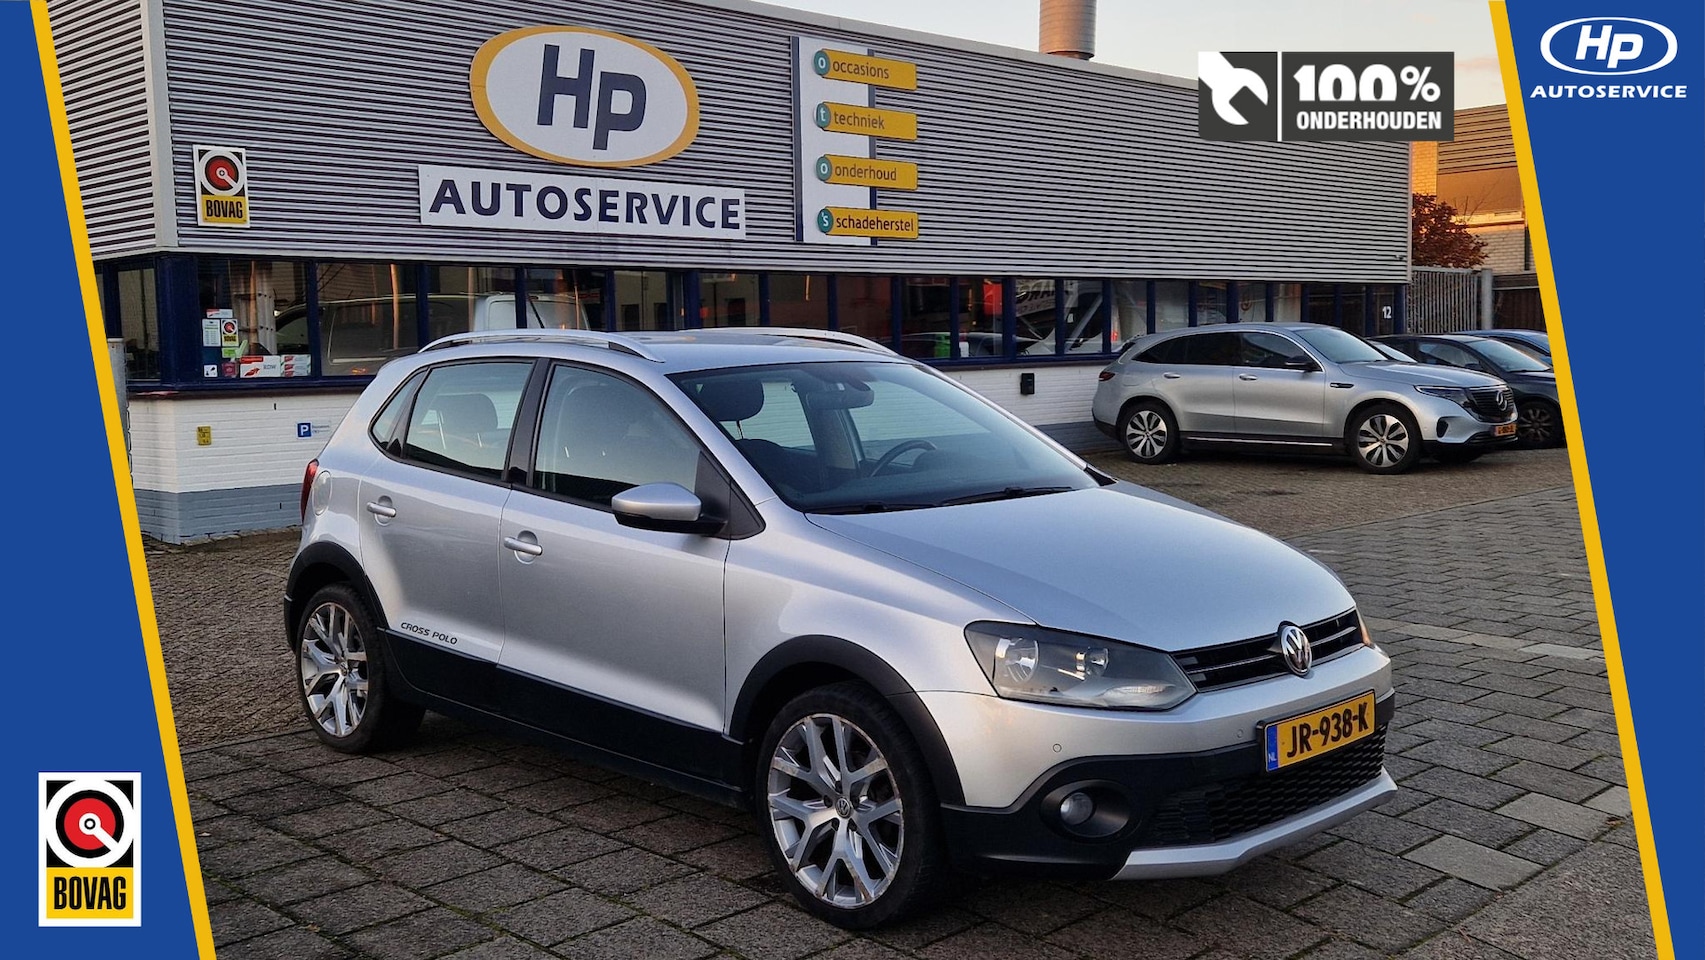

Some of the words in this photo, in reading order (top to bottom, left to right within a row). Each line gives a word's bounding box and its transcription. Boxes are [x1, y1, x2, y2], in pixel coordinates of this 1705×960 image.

[832, 61, 890, 79] occasions
[537, 44, 646, 150] Hp
[834, 111, 885, 129] techniek
[834, 163, 897, 181] onderhoud
[206, 200, 243, 218] BOVAG
[429, 179, 740, 229] AUTOSERVICE
[836, 215, 914, 231] schadeherstel
[1382, 305, 1392, 319] 12
[300, 425, 308, 435] P
[401, 622, 430, 636] CROSS
[432, 631, 458, 645] POLO
[1286, 702, 1369, 758] JR-938-K
[1268, 752, 1277, 762] NL
